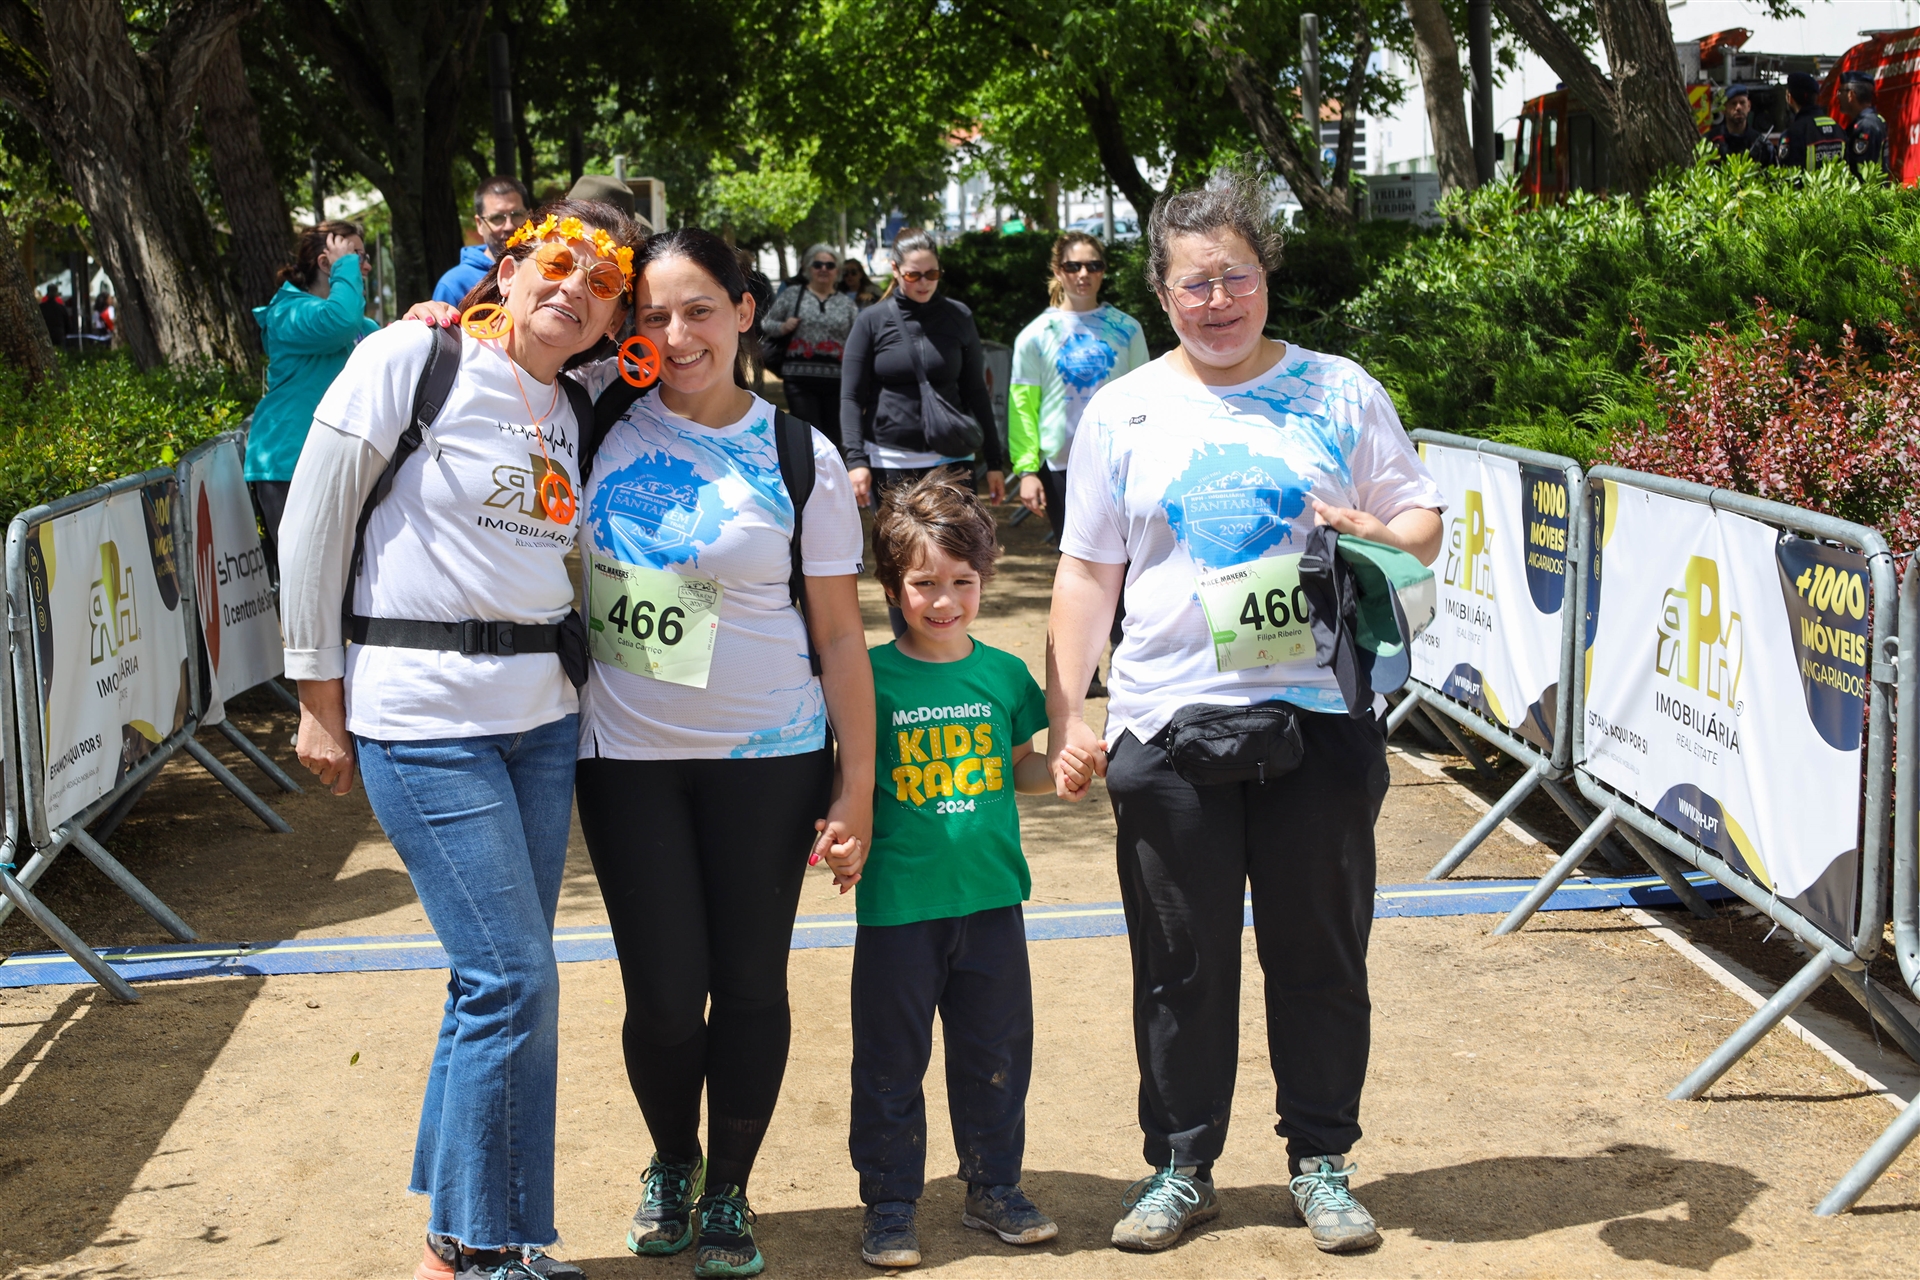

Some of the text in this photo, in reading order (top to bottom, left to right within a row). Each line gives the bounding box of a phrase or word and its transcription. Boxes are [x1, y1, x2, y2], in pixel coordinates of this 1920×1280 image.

[1374, 187, 1412, 200] TRILHO
[1372, 202, 1416, 214] ERDIDO
[613, 494, 691, 525] SANTARÉM
[1190, 495, 1271, 513] SANTARÉM
[1532, 480, 1566, 519] +1000
[630, 523, 662, 542] 2026
[670, 521, 687, 531] TRAIL
[1219, 522, 1253, 536] 2026
[1530, 518, 1565, 552] IMÓVEIS
[607, 565, 630, 579] MAKERS
[1527, 551, 1564, 575] ANGARIADOS
[1220, 570, 1248, 582] MAKERS
[1795, 563, 1865, 620] +1000
[223, 603, 231, 627] O
[231, 599, 257, 625] centro
[608, 594, 686, 646] 466
[1239, 585, 1310, 631] 460
[617, 636, 662, 655] Cátia Carriço
[1257, 628, 1302, 642] Filipa Ribeiro
[1800, 615, 1866, 667] IMÓVEIS
[1802, 657, 1864, 699] ANGARIADOS
[892, 702, 991, 727] McDonald's
[1655, 691, 1740, 755] IMOBILIÁRIA
[79, 737, 96, 756] POR
[897, 723, 993, 764] KIDS
[1610, 723, 1629, 744] AQUI
[1629, 730, 1642, 752] POR
[1642, 738, 1648, 756] SI
[1676, 732, 1692, 753] REAL
[891, 756, 1003, 807] RACE
[936, 799, 976, 814] 2024
